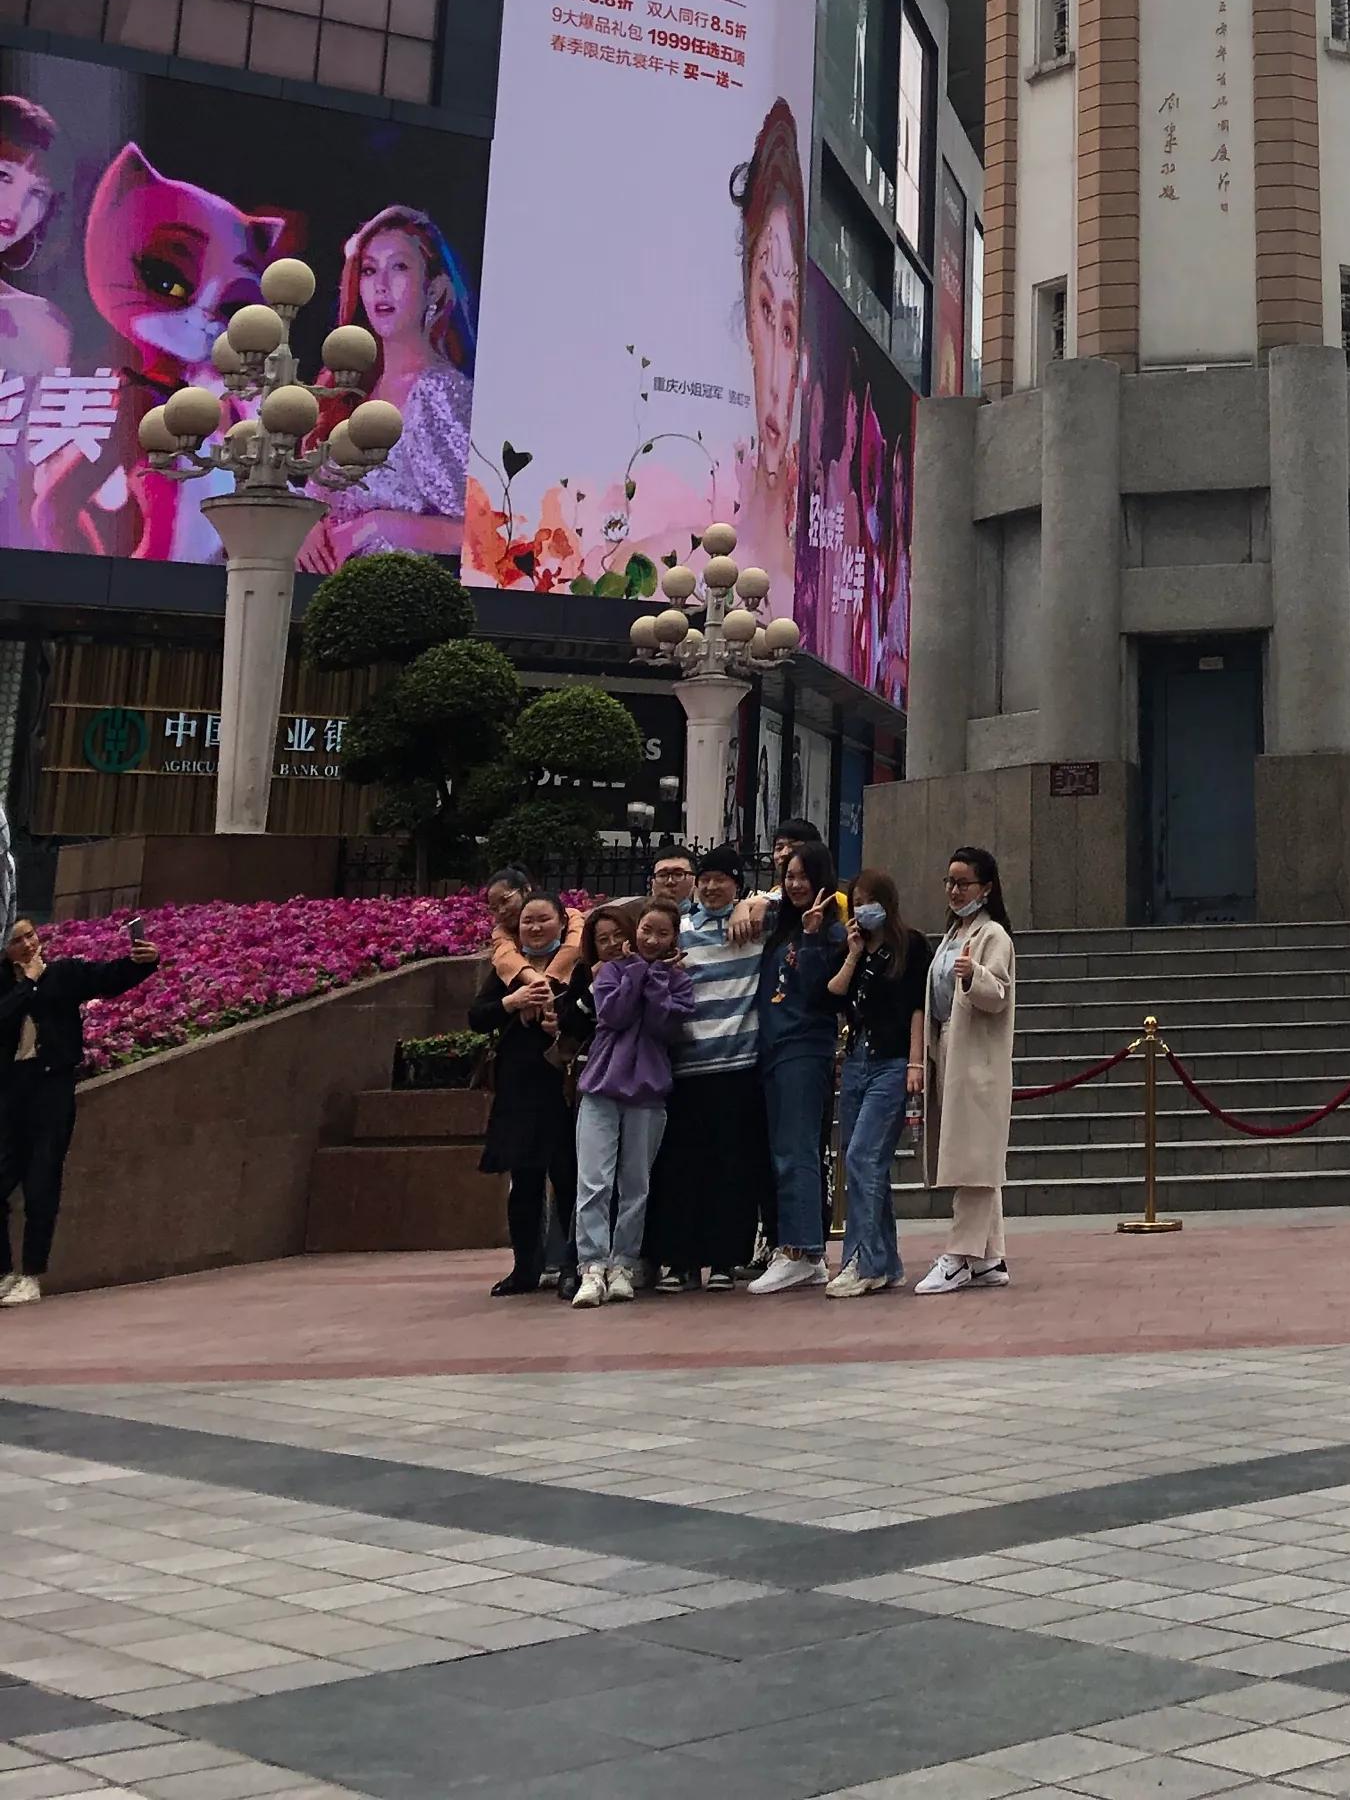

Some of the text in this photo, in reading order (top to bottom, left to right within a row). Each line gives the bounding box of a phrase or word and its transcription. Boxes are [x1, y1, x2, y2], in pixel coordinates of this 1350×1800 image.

[647, 0, 748, 42] 双人同行8.5折
[683, 61, 744, 90] 买一送一
[279, 764, 319, 777] BANK
